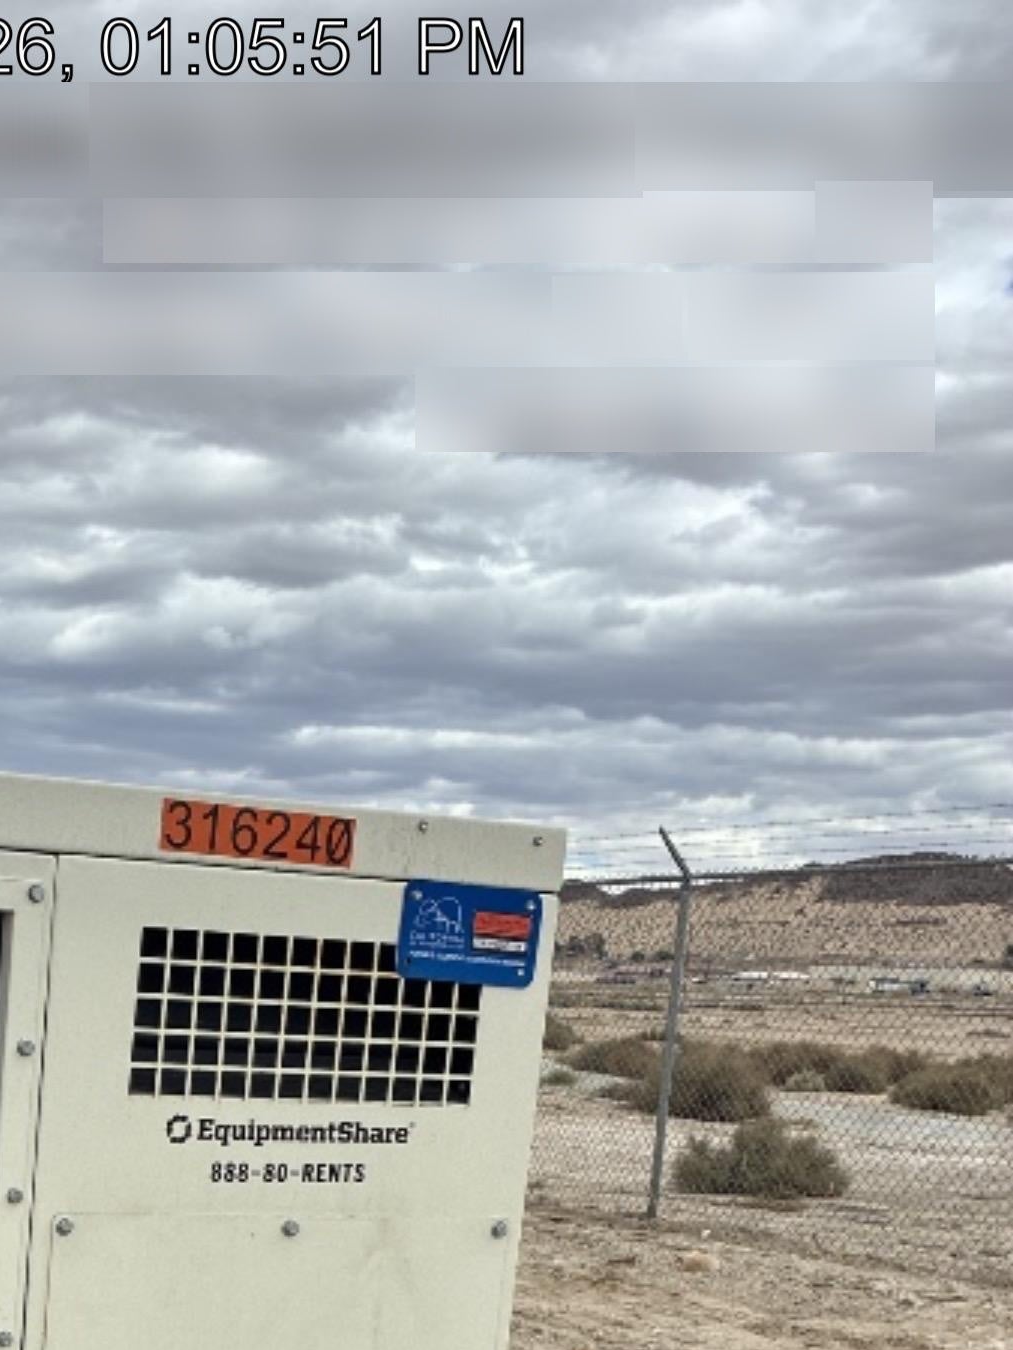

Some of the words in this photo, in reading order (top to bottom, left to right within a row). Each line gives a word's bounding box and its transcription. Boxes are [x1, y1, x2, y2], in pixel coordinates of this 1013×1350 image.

[166, 801, 354, 865] 316240
[196, 1118, 409, 1147] EquipmentShare
[211, 1161, 366, 1184] 888-80-RENTS
